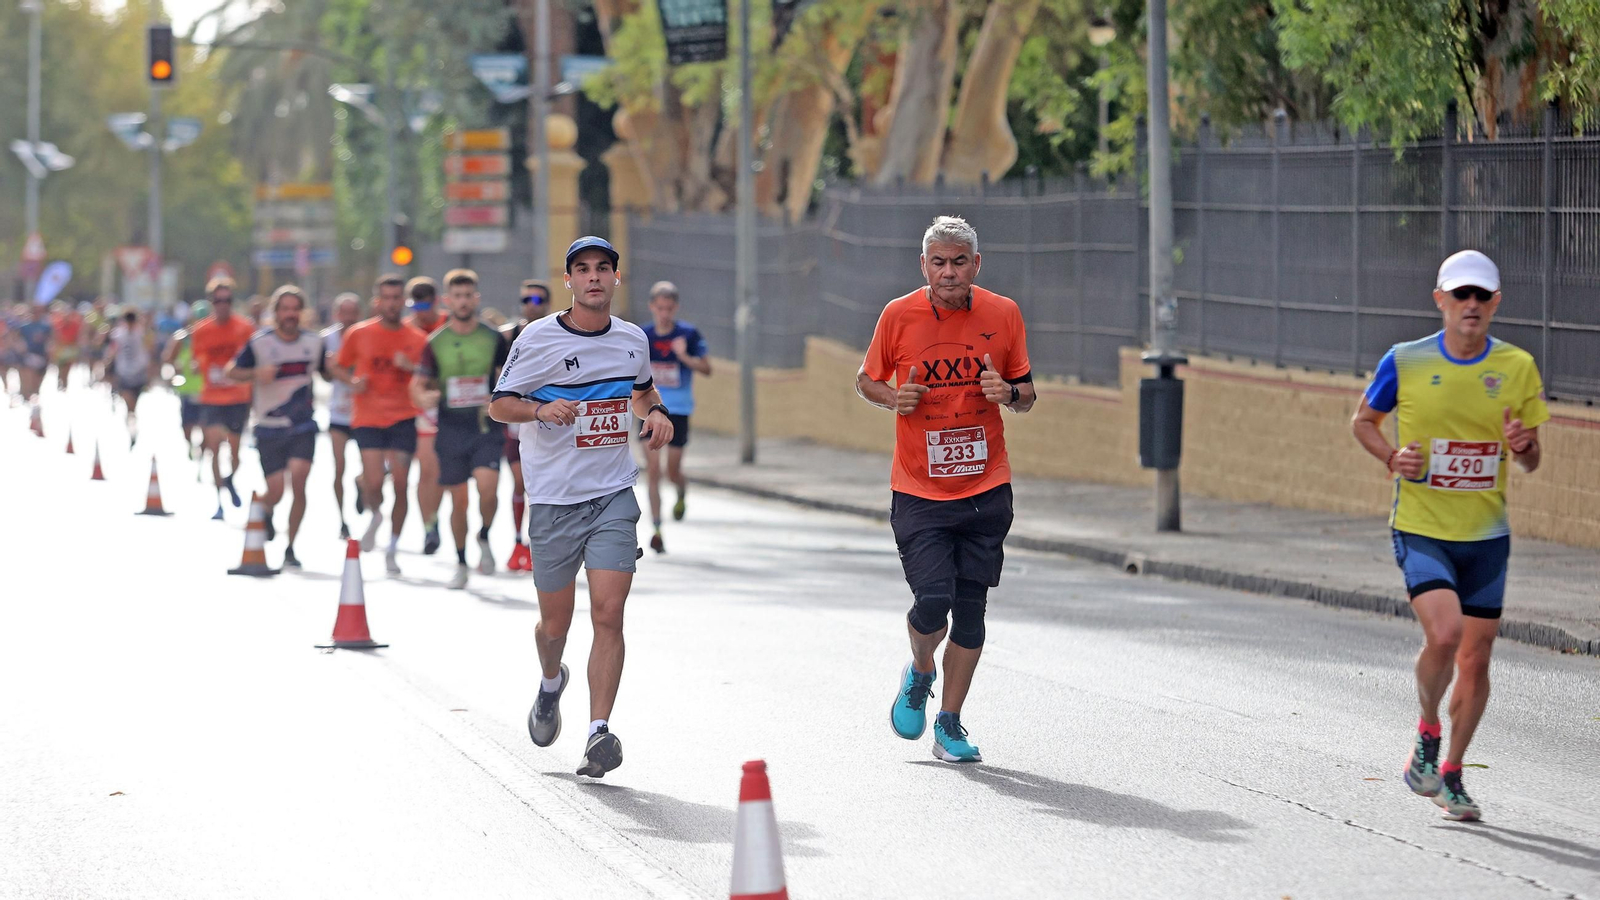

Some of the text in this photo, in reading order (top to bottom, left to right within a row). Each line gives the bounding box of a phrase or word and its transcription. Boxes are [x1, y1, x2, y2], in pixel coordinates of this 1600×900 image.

[590, 416, 619, 432] 448
[943, 444, 975, 461] 233
[1448, 458, 1483, 474] 490
